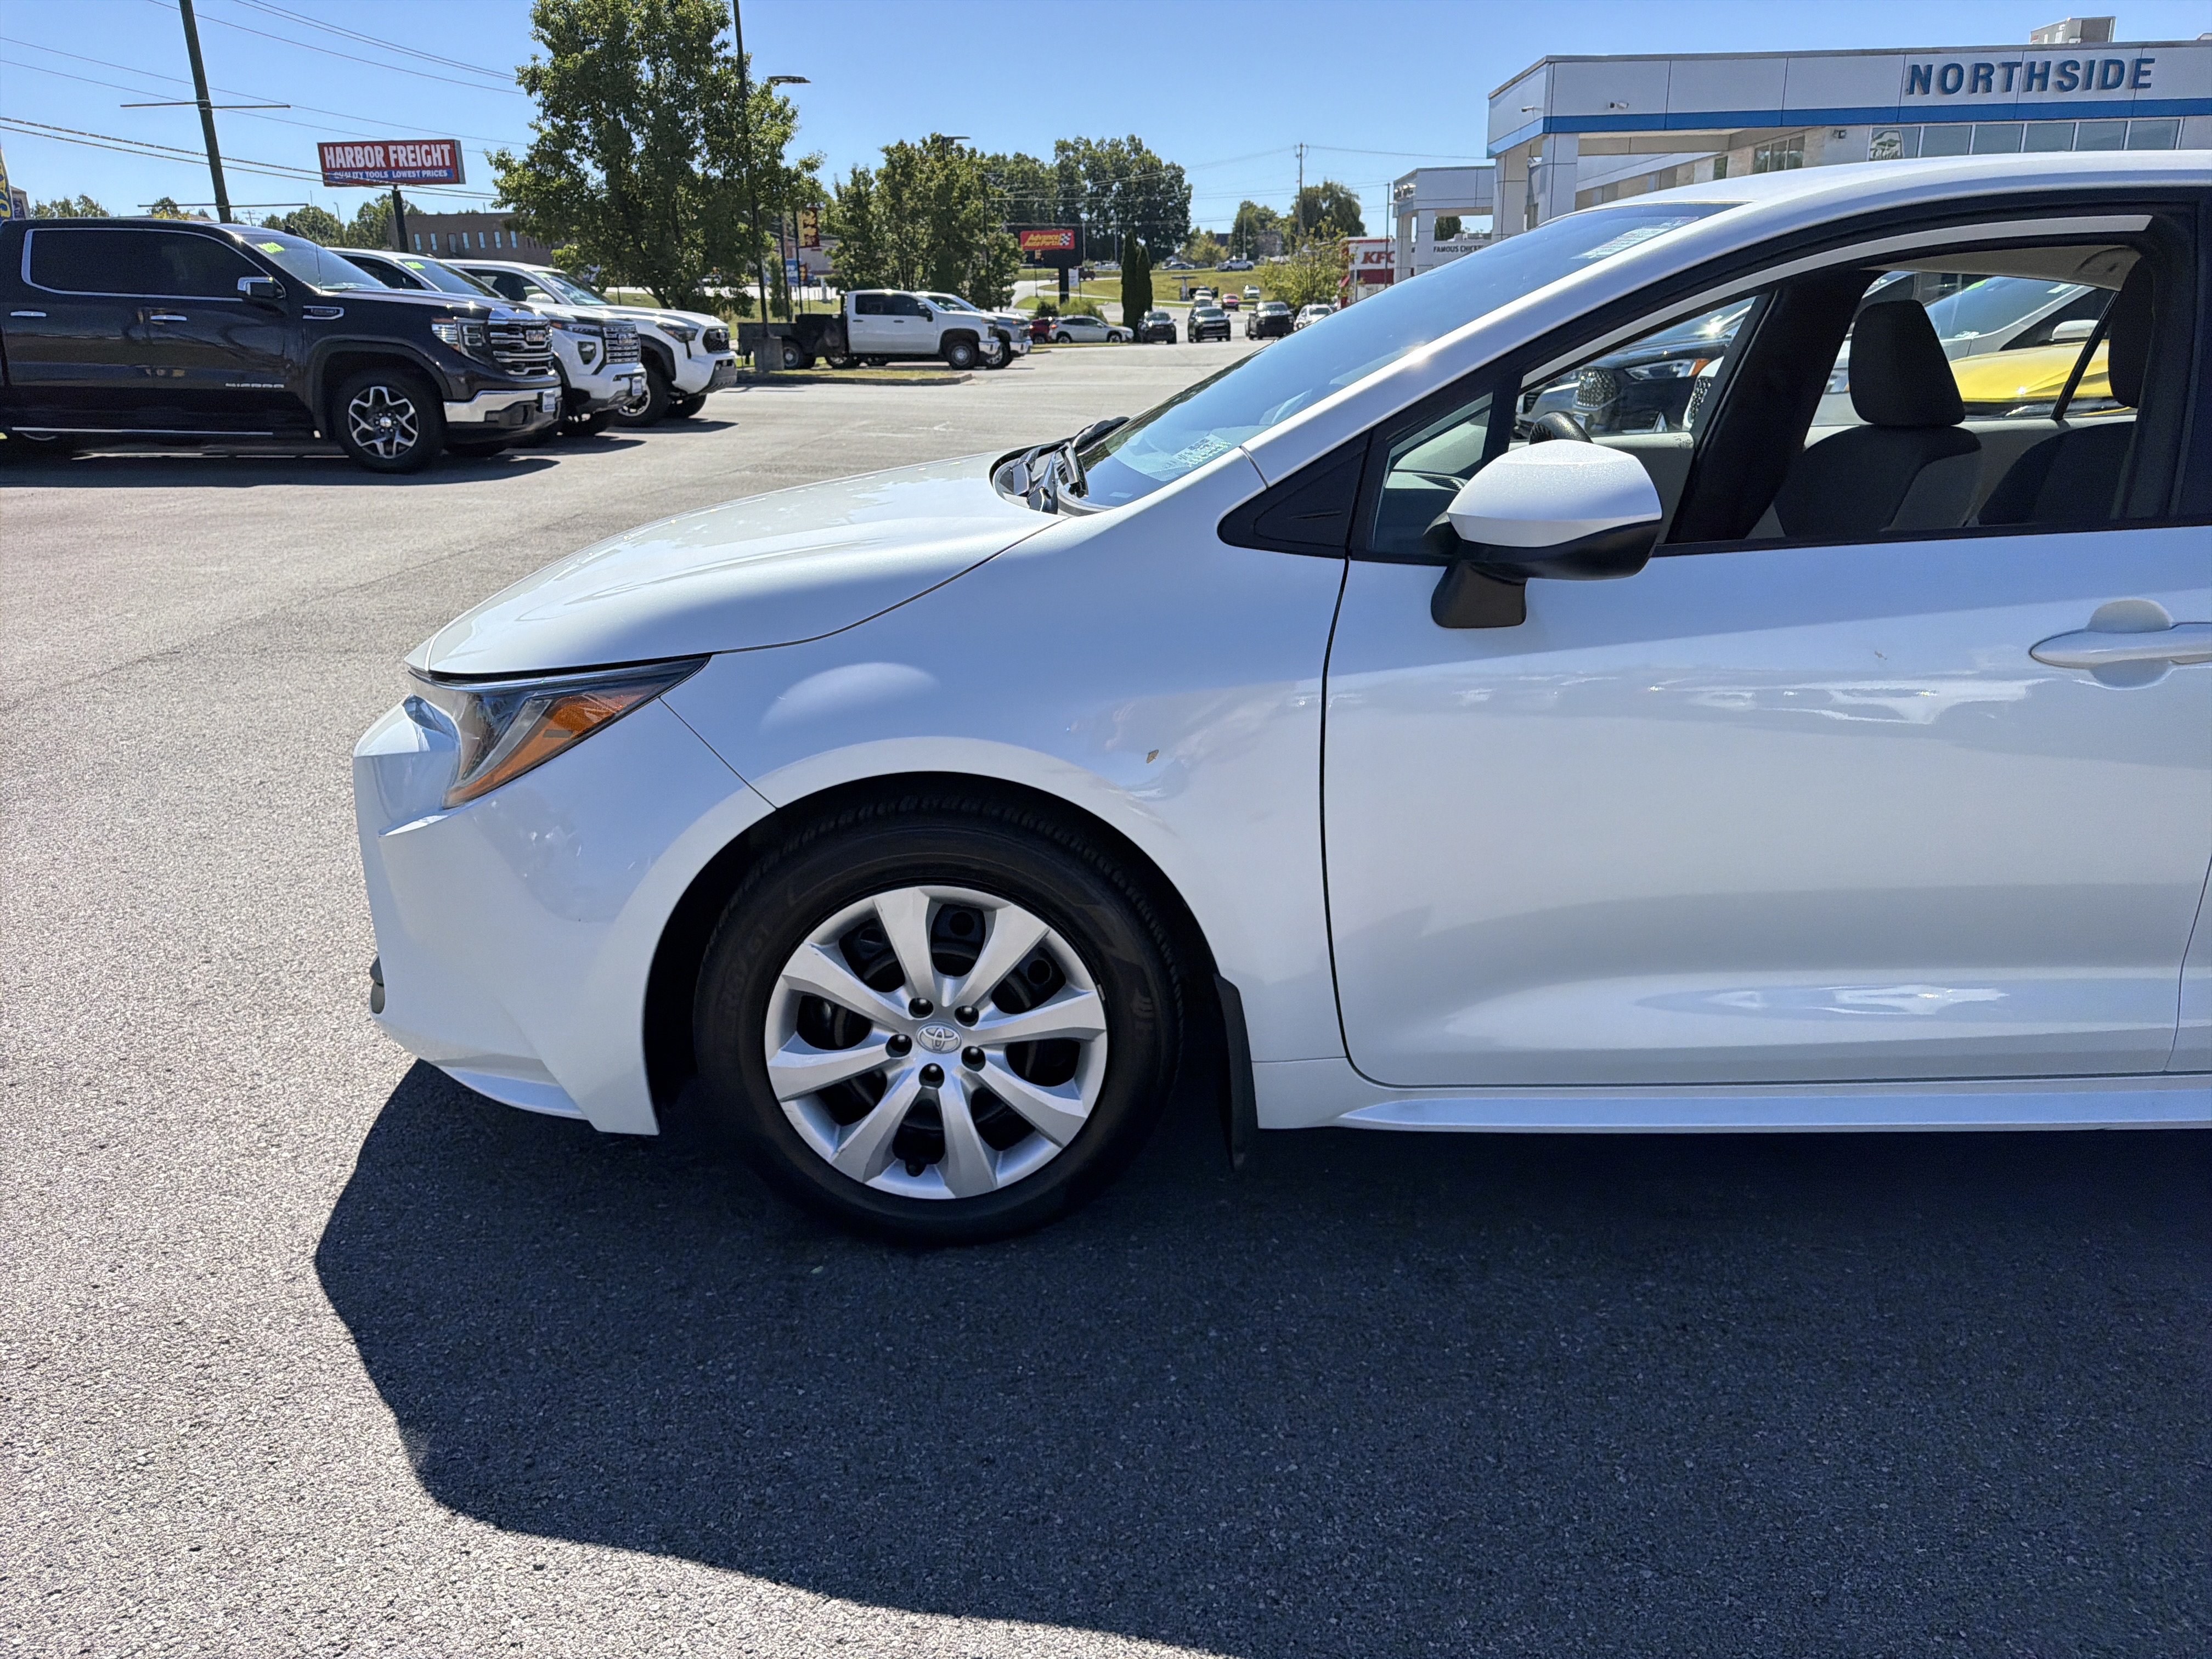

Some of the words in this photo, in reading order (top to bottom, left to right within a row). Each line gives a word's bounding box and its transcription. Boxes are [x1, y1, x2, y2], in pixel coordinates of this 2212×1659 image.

[1907, 58, 2155, 96] NORTHSIDE
[323, 145, 386, 168] HARBOR
[388, 144, 451, 167] FREIGHT
[392, 170, 421, 178] LOWEST
[421, 169, 448, 177] PRICES
[1361, 250, 1396, 264] KFC
